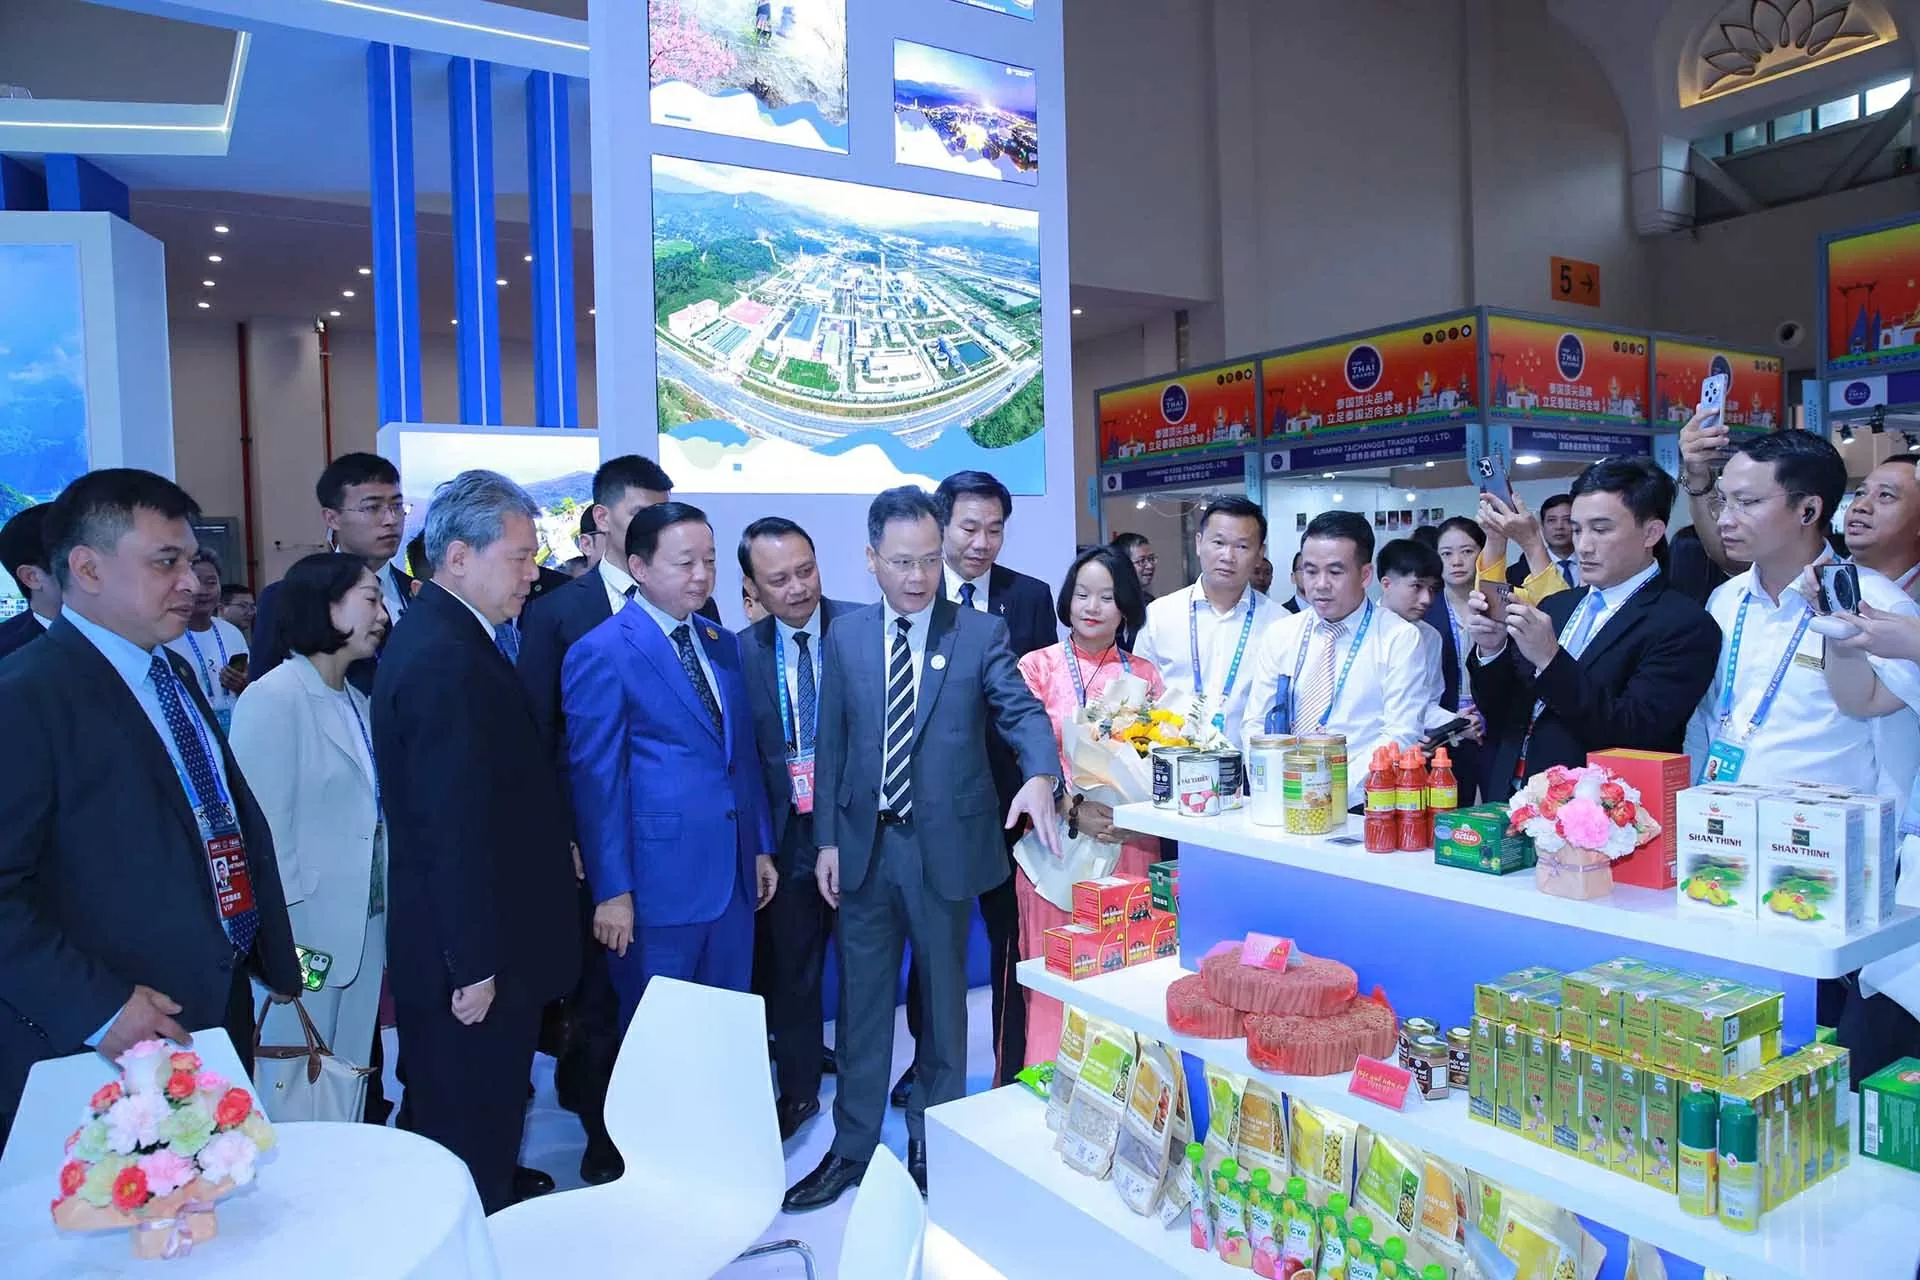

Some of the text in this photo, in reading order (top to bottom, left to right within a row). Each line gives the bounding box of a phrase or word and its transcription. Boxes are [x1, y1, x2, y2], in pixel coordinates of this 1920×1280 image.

[1560, 264, 1571, 294] 5
[1352, 364, 1375, 374] THAI
[1689, 833, 1713, 843] SHAN
[1771, 844, 1798, 854] SHAN
[223, 903, 233, 911] VIP
